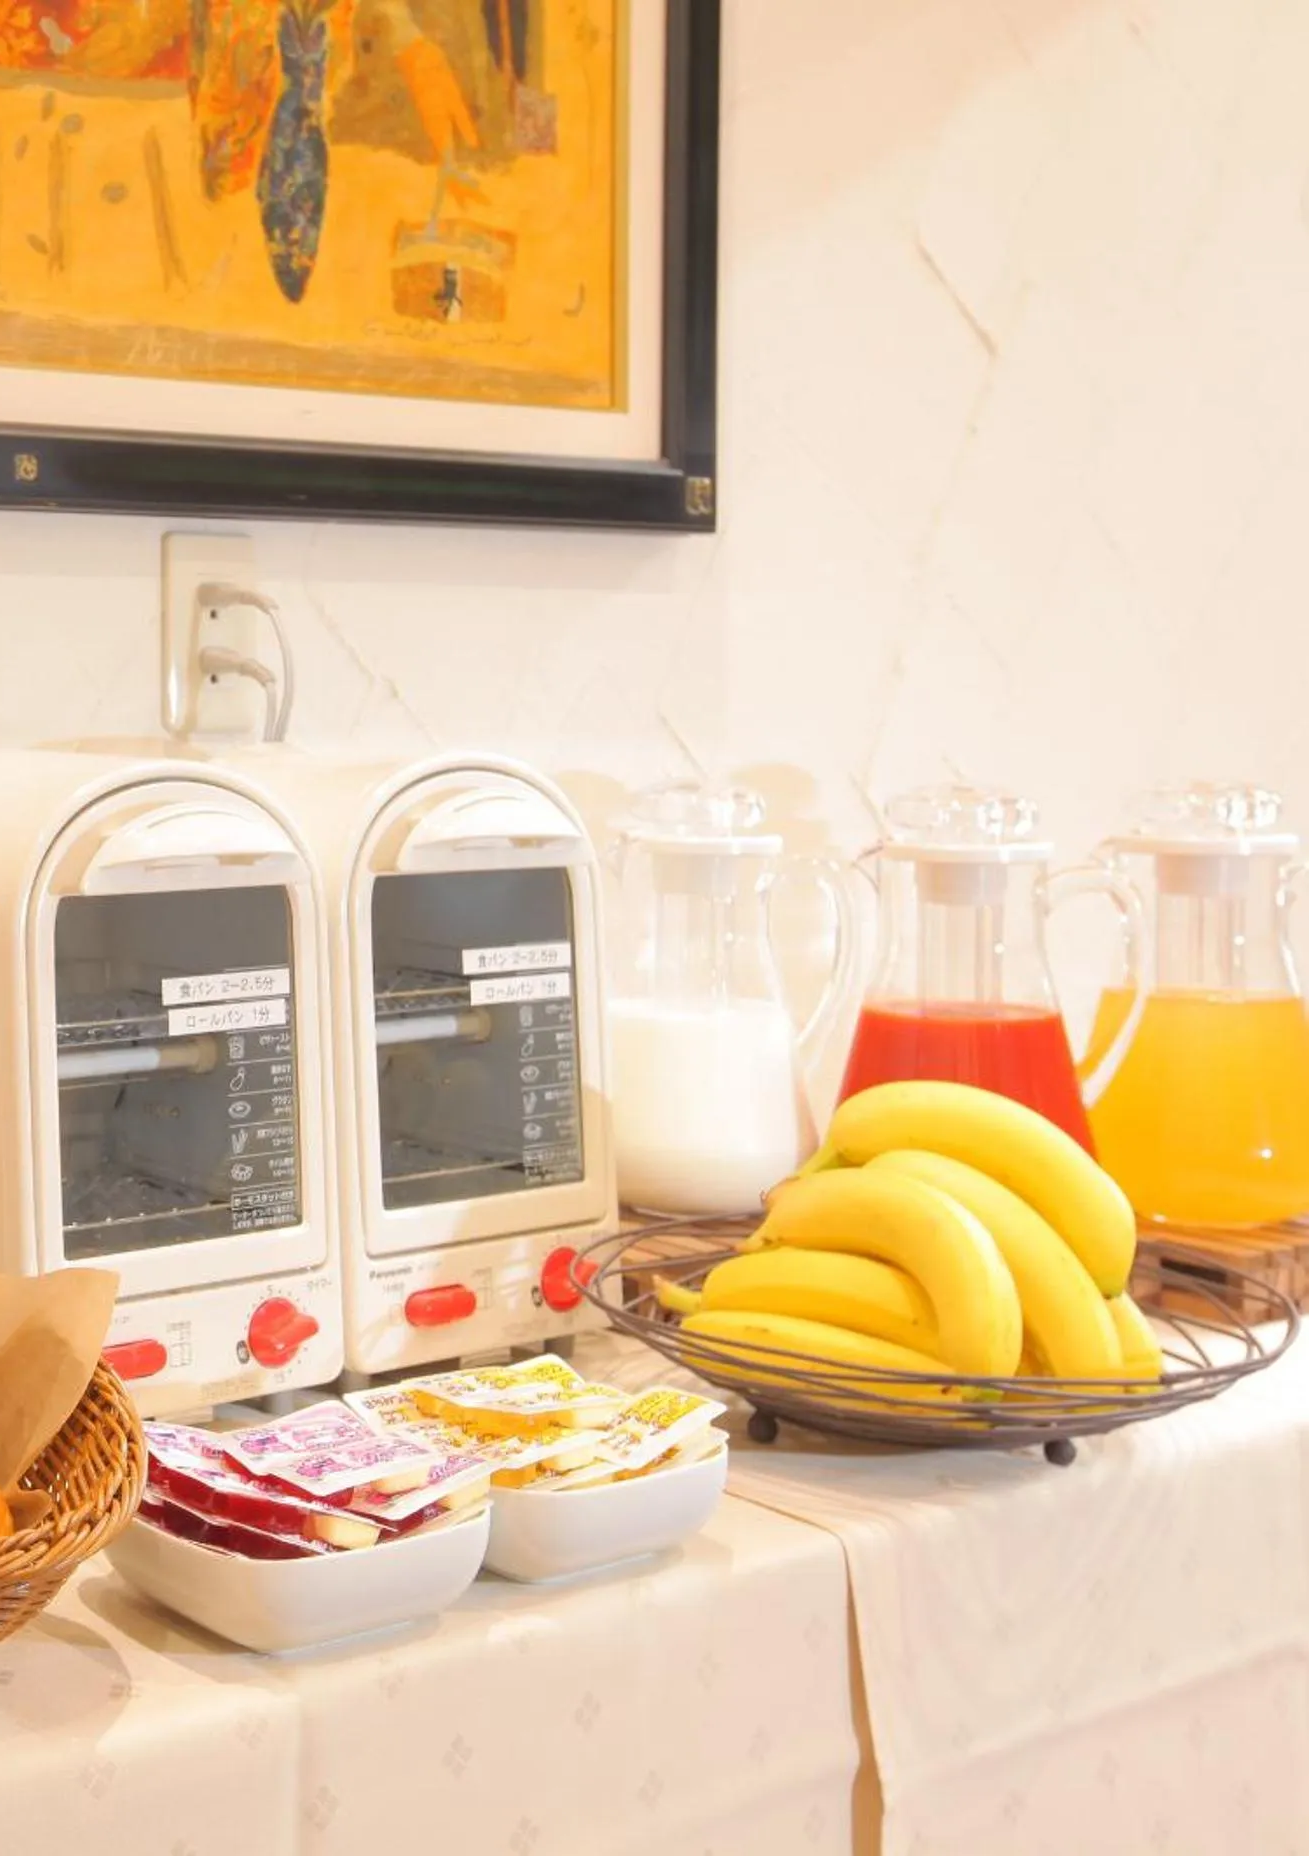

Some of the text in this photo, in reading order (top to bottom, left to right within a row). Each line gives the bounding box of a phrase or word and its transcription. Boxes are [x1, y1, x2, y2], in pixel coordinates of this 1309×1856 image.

[185, 1006, 244, 1029] ロールパン
